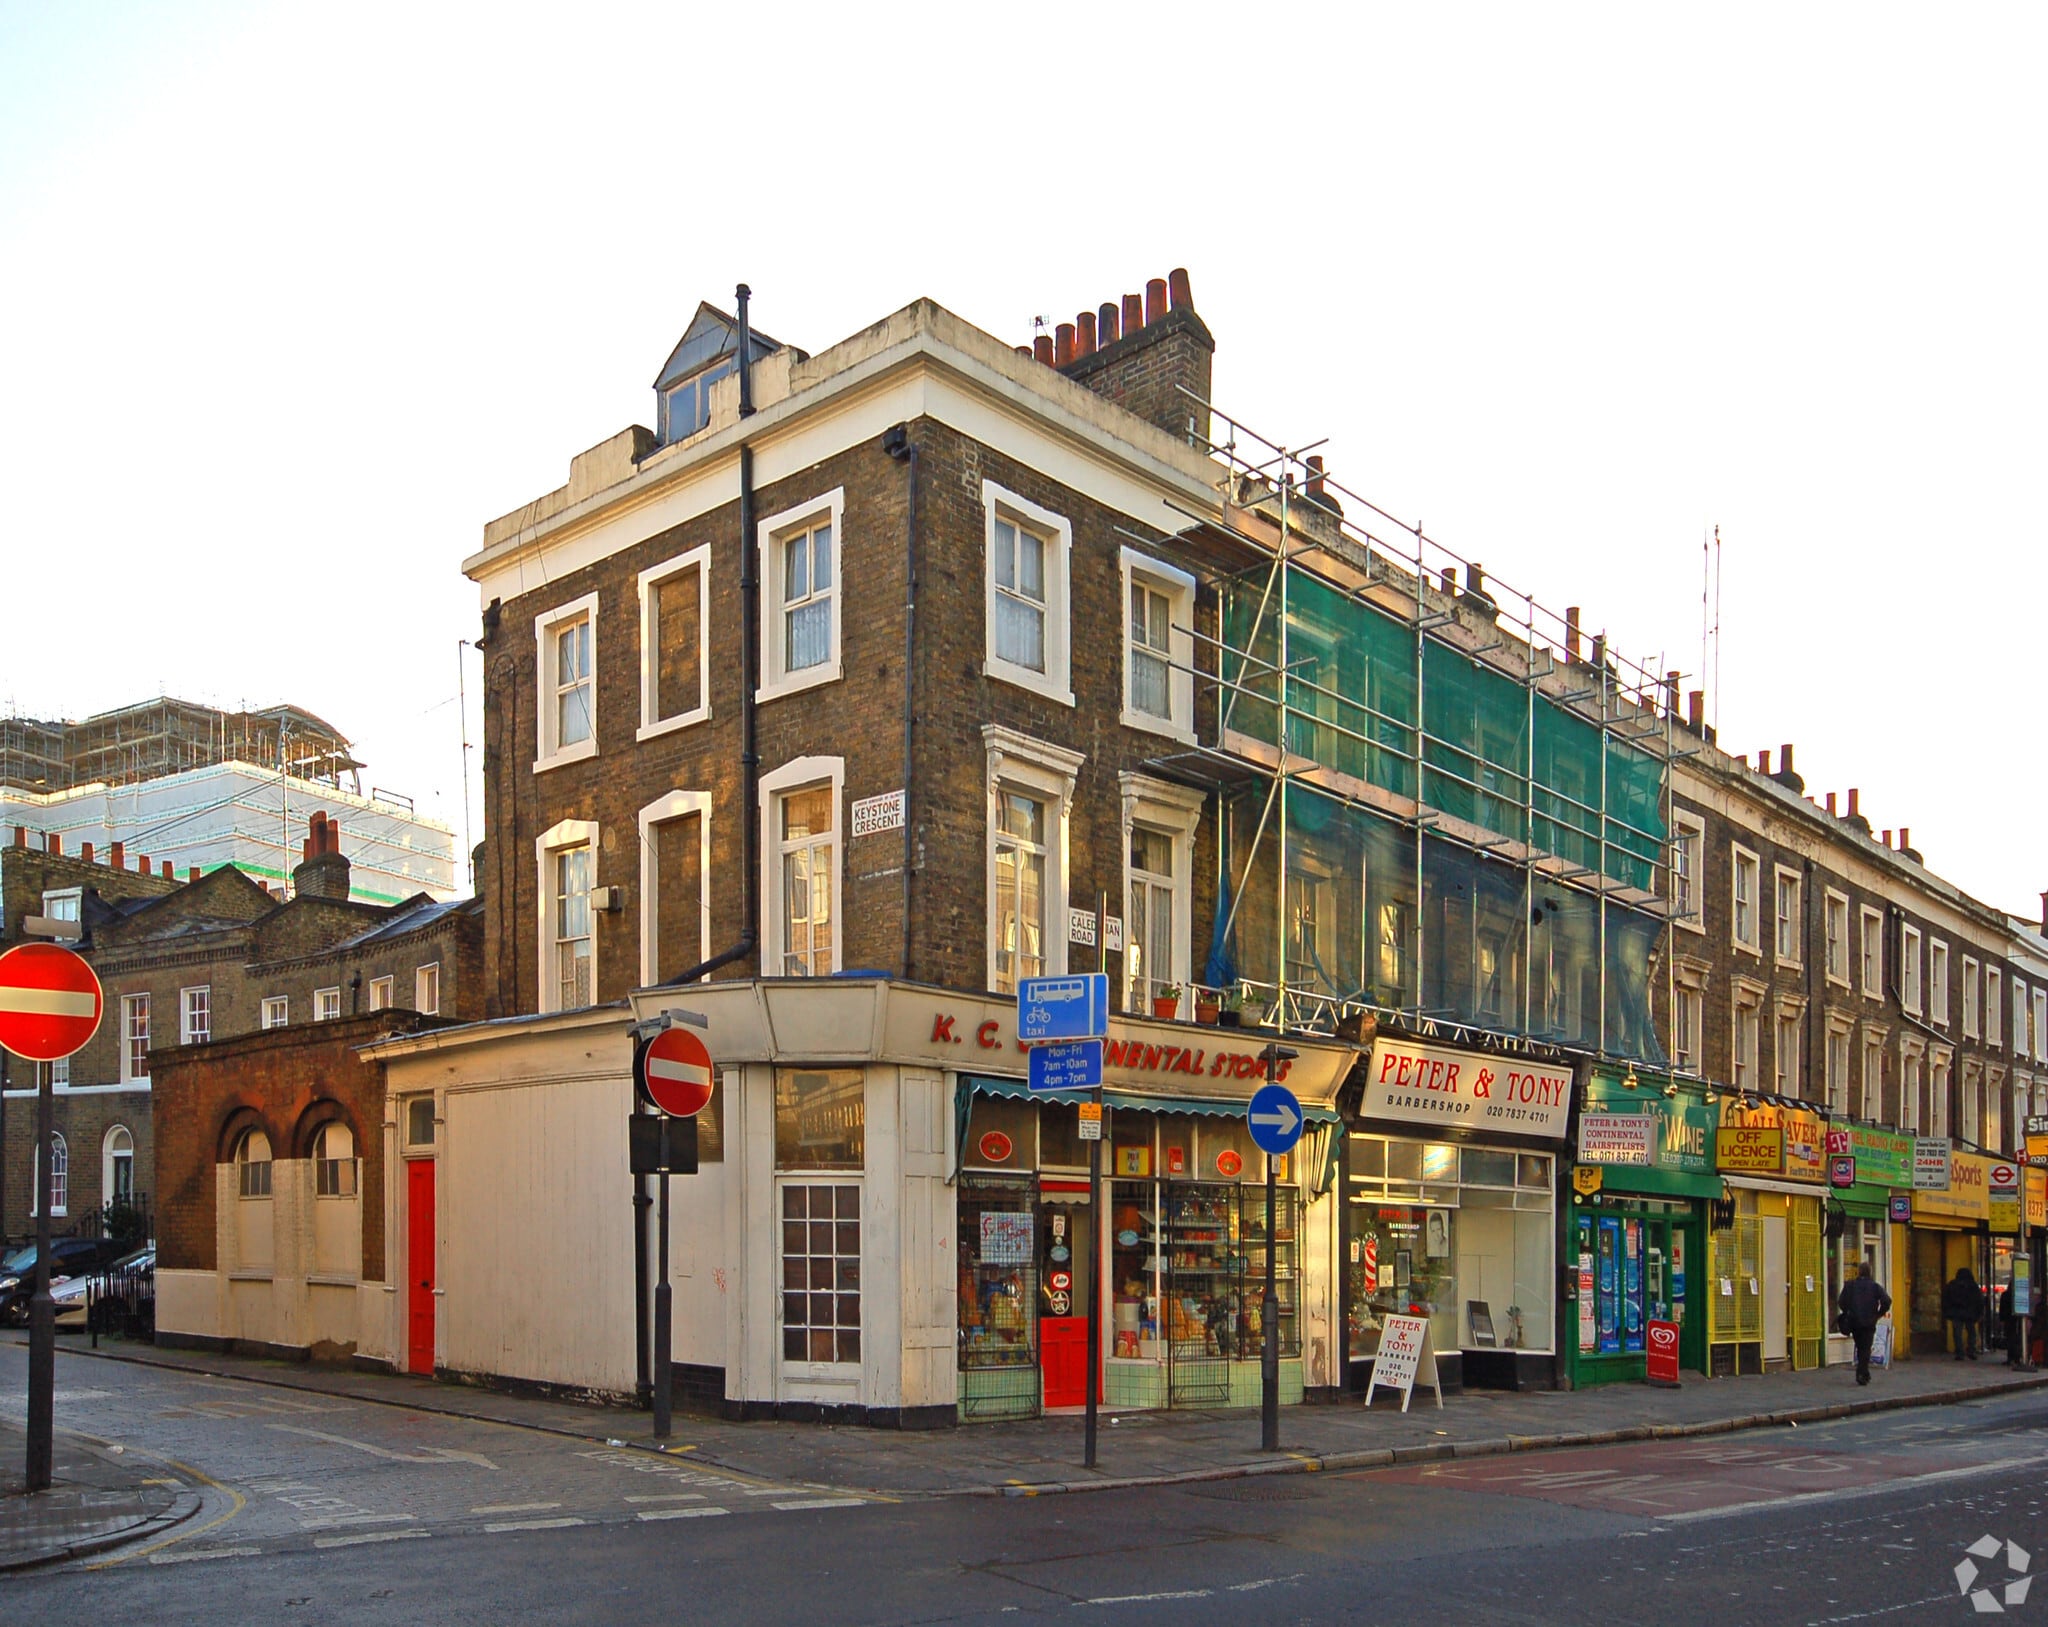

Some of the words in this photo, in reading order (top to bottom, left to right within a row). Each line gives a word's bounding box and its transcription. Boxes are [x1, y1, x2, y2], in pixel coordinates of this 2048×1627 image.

[854, 799, 900, 821] KEYSTONE
[855, 813, 899, 834] CRESCENT
[1071, 928, 1093, 943] ROAD
[1026, 1026, 1046, 1037] taxi
[931, 1013, 962, 1044] K.
[977, 1020, 1003, 1050] C.
[1211, 1053, 1292, 1082] STORS
[1379, 1053, 1460, 1095] PETER
[1473, 1068, 1495, 1099] &
[1507, 1072, 1567, 1107] TONY
[1387, 1094, 1471, 1114] BARBERSHOP
[1487, 1105, 1503, 1118] 020
[1506, 1107, 1527, 1120] 7837
[1530, 1111, 1550, 1124] 4701
[1584, 1118, 1610, 1127] PETER
[1613, 1119, 1619, 1127] &
[1586, 1129, 1645, 1140] CONTINENTAL
[1664, 1114, 1705, 1155] WINE
[1736, 1131, 1762, 1144] OFF
[1585, 1141, 1646, 1151] HAIRSTYLISTS
[1721, 1145, 1777, 1158] LICENCE
[1599, 1150, 1615, 1161] 0171
[1616, 1151, 1630, 1162] 837
[1632, 1152, 1649, 1163] 4701
[1728, 1159, 1749, 1167] OPEN
[1916, 1158, 1944, 1166] 24HR
[1388, 1319, 1421, 1332] PETER
[1398, 1331, 1408, 1341] &
[1386, 1340, 1415, 1352] TONY
[1376, 1368, 1393, 1376] 7837
[1388, 1362, 1402, 1370] 020
[1643, 1446, 1881, 1473] BUS
